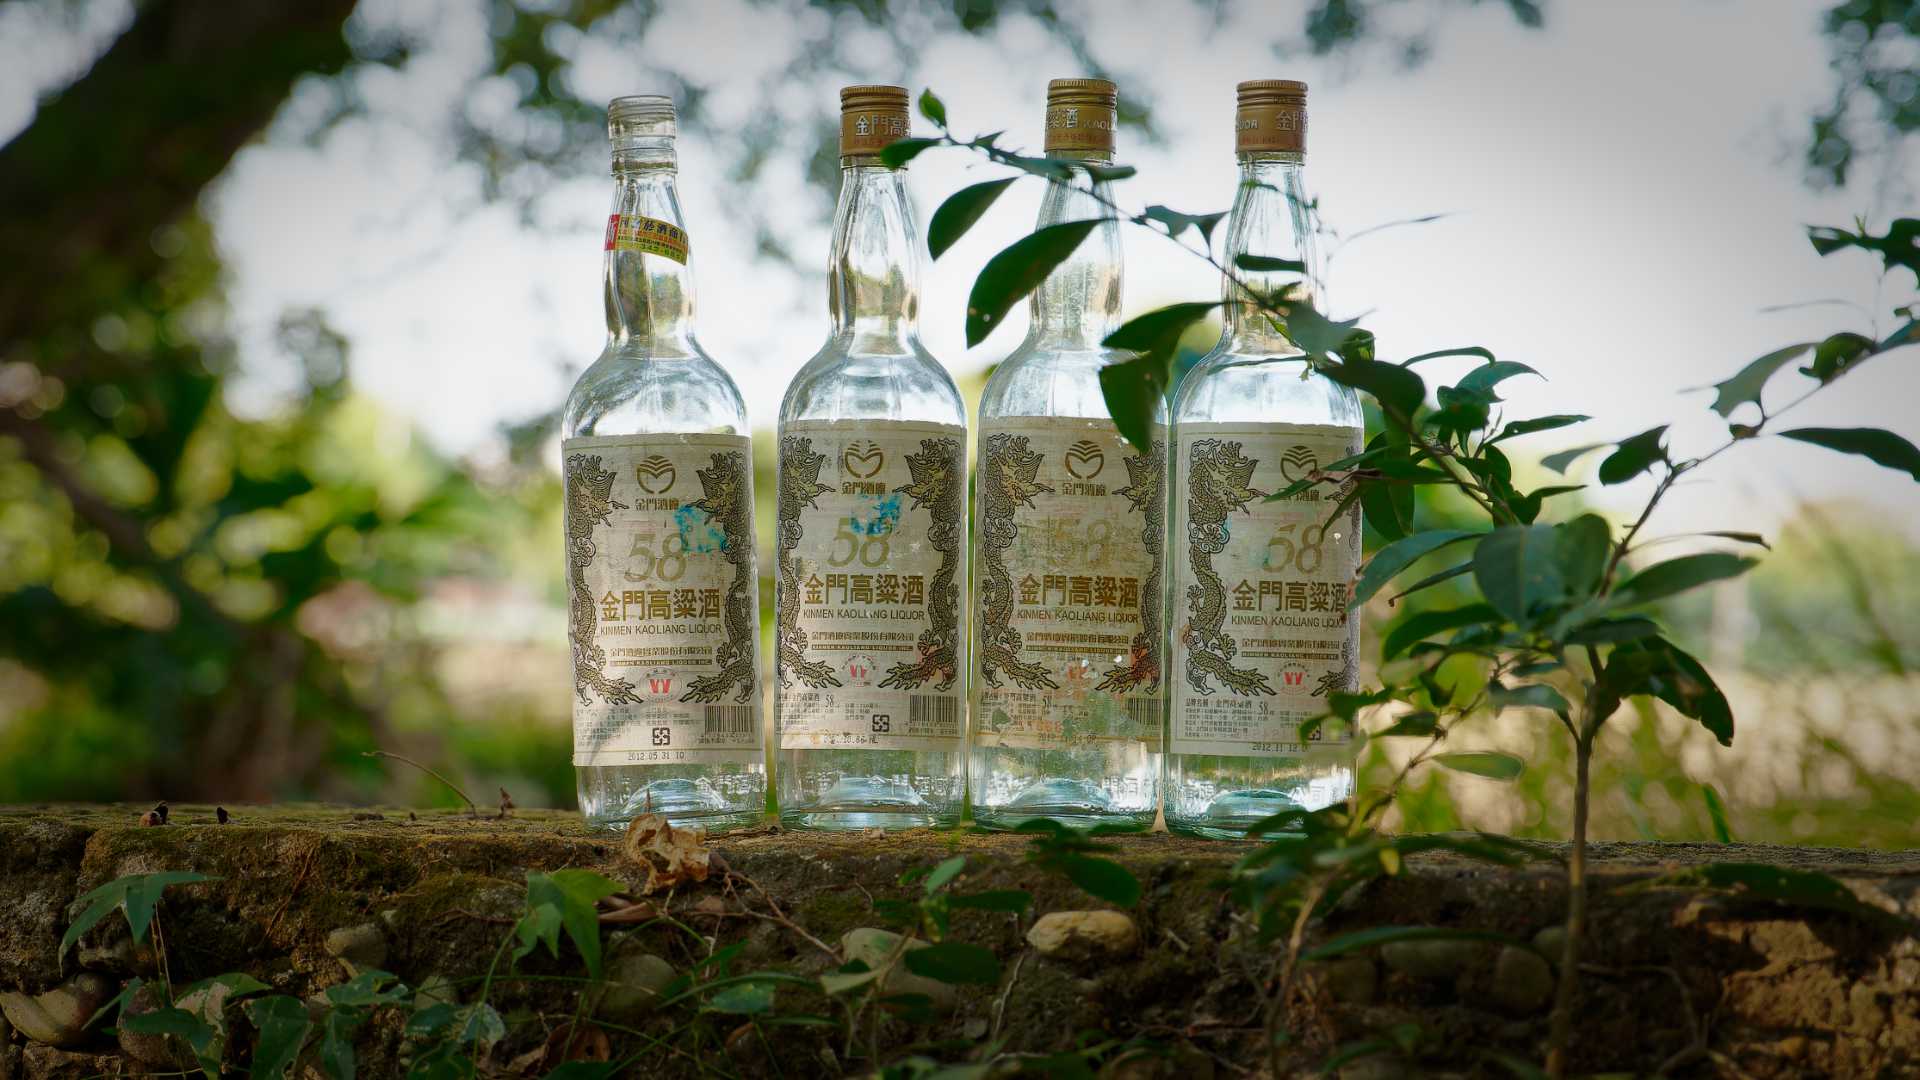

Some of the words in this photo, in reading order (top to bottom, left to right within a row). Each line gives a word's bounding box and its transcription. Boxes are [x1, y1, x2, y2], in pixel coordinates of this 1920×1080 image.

[623, 532, 688, 582] 58
[827, 517, 893, 568] 58
[1263, 523, 1323, 575] 58
[600, 588, 722, 622] 金門高粱酒
[804, 573, 925, 606] 金門高粱酒
[1018, 573, 1139, 608] 金門高粱酒
[1231, 579, 1347, 613] 金門高粱酒
[600, 624, 632, 636] KINMEN
[635, 623, 686, 635] KAOLIANG
[688, 622, 722, 635] LIQUOR
[803, 608, 834, 619] KINMEN
[891, 609, 925, 621] LIQUOR
[1017, 608, 1052, 620] KINMEN
[1055, 607, 1106, 622] KAOLIANG
[1108, 611, 1139, 624] LIQUOR
[1231, 615, 1269, 626] KINMEN
[1271, 616, 1320, 628] KAOLIANG
